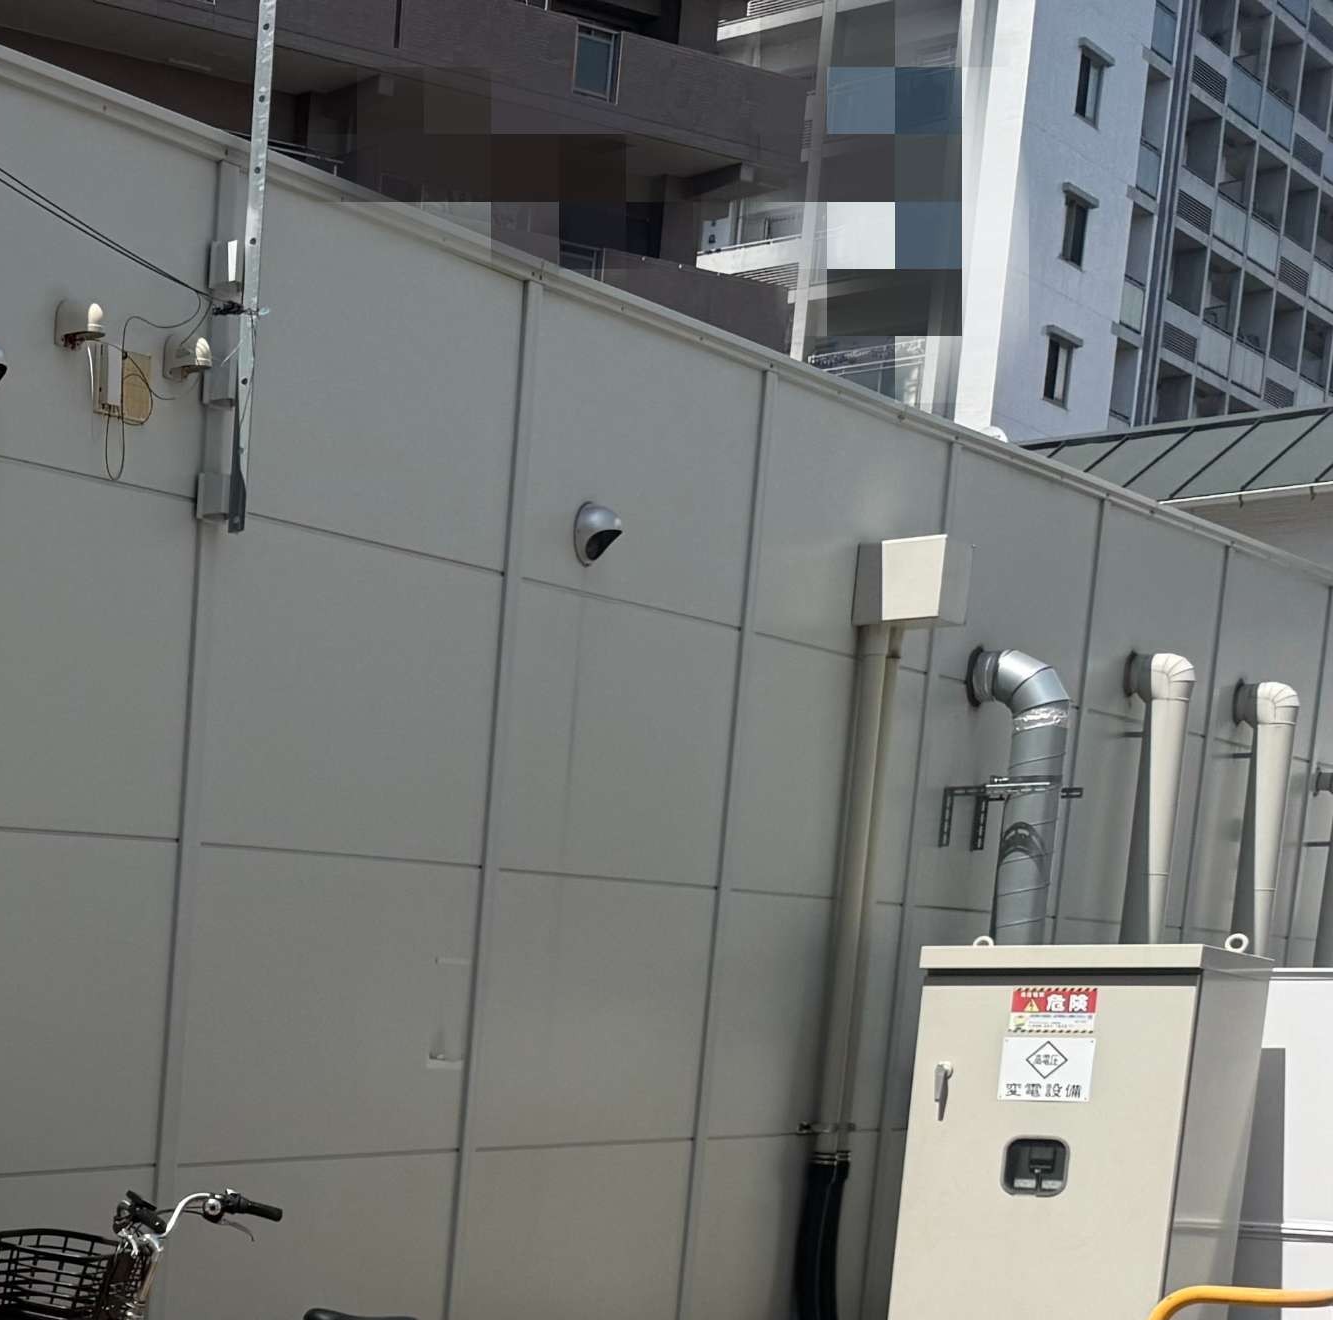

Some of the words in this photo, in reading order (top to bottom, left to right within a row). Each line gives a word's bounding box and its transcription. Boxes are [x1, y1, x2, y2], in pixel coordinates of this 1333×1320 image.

[1046, 994, 1089, 1012] 危険
[1005, 1083, 1082, 1098] 変電設備
